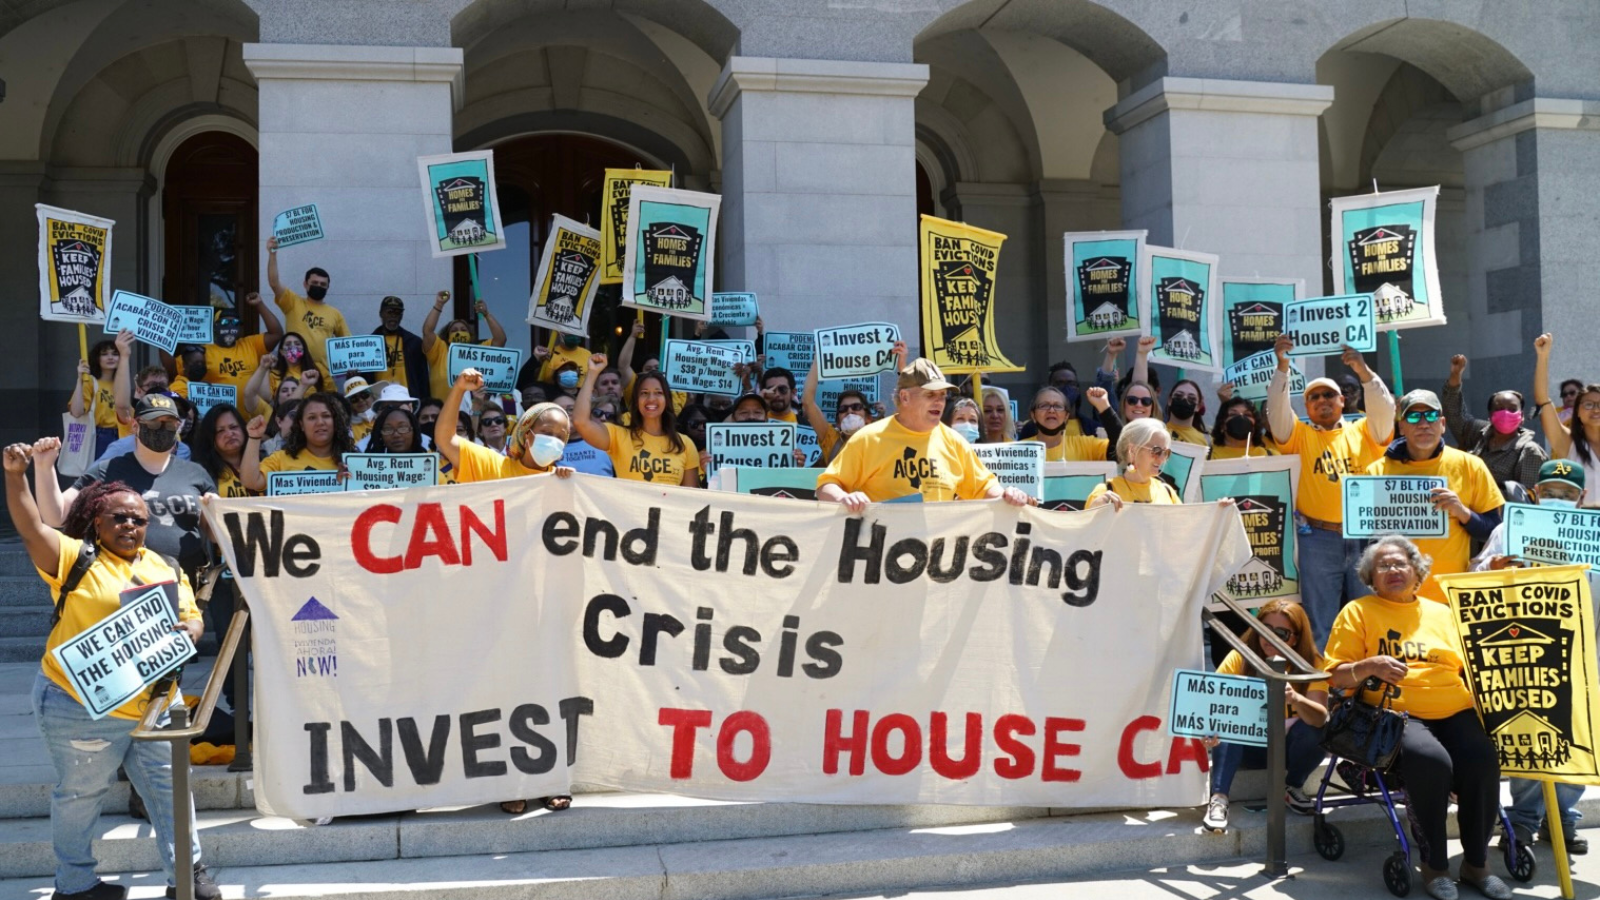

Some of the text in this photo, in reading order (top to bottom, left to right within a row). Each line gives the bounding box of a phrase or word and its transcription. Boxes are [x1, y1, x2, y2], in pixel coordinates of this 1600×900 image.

[448, 188, 474, 200] HOMES
[301, 207, 314, 216] FOR
[447, 200, 480, 212] FAMILIES
[289, 215, 316, 226] HOUSING
[53, 221, 104, 237] BAN COVID
[275, 224, 313, 237] PRODUCTION
[277, 229, 320, 244] PRESERVATION
[52, 231, 103, 246] EVICTIONS
[561, 231, 601, 250] BAN COVI
[657, 237, 687, 251] HOMES
[559, 240, 601, 260] EVICTIONS
[934, 237, 995, 260] BAN COVID
[1364, 240, 1399, 258] HOMES
[62, 253, 89, 265] KEEP
[653, 253, 692, 268] FAMILIES
[934, 250, 994, 272] EVICTIONS
[1361, 257, 1407, 276] FAMILIES
[61, 264, 94, 278] FAMILIES
[560, 261, 584, 274] KEEP
[1090, 269, 1118, 281] HOMES
[59, 275, 92, 288] HOUSED
[551, 282, 579, 296] HOUSED
[1088, 282, 1123, 294] FAMILIES
[1169, 291, 1192, 306] HOMES
[115, 302, 150, 318] ACABAR
[151, 313, 169, 326] CON
[169, 320, 178, 332] LA
[145, 300, 181, 323] PODEMOS
[718, 311, 746, 319] Creciente
[1300, 300, 1367, 323] Invest 2
[137, 317, 176, 339] CRISIS DE
[1243, 315, 1275, 327] HOMES
[136, 326, 173, 348] VIVIENDA
[196, 332, 206, 340] $14
[833, 327, 895, 346] Invest 2
[1240, 330, 1281, 342] FAMILIES
[1288, 324, 1368, 347] House CA
[334, 340, 377, 350] MÁS Fondos
[686, 344, 725, 357] Avg. Rent
[768, 342, 796, 351] ACABAR
[797, 343, 811, 351] CON
[348, 351, 365, 360] para
[458, 347, 511, 364] MÁS Fondos
[674, 352, 708, 366] Housing
[788, 352, 810, 360] CRISIS
[822, 349, 893, 370] House CA
[332, 359, 383, 370] MÁS Viviendas
[680, 364, 727, 377] $38 p/hour
[1234, 354, 1273, 374] WE CAN
[672, 374, 733, 389] Min. Wage: $14
[843, 383, 875, 393] HOUSING
[195, 386, 234, 397] WE CAN END
[725, 428, 790, 447] Invest 2
[566, 450, 596, 458] TENANTS
[566, 454, 596, 462] TOGETHER
[995, 447, 1038, 458] Viviendas
[366, 458, 414, 471] Avg. Rent
[629, 455, 672, 473] ACCE
[768, 453, 790, 468] CA
[894, 457, 940, 479] ACCE
[985, 459, 1029, 471] onómicas
[274, 477, 294, 488] Mas
[355, 470, 426, 485] Housing Wage:
[1384, 480, 1438, 491] $7 BL FOR
[1390, 493, 1439, 504] HOUSING
[1358, 506, 1439, 517] PRODUCTION &
[1359, 519, 1439, 530] PRESERVATION
[1553, 512, 1568, 525] $7
[1571, 514, 1586, 527] BL
[1254, 546, 1280, 556] PROFIT!
[1522, 535, 1600, 553] PRODUCTION
[223, 499, 1103, 608] We CAN end the Housing
[1523, 547, 1600, 566] PRESERVATIO
[1458, 586, 1571, 608] BAN COVID
[1459, 601, 1574, 624] EVICTIONS
[75, 596, 163, 660] WE CAN END
[294, 620, 335, 634] HOUSING
[583, 593, 845, 680] Crisis
[77, 617, 172, 687] THE HOUSING
[136, 636, 186, 678] CRISIS
[296, 645, 336, 656] AHORA!
[1481, 645, 1545, 667] KEEP
[1479, 667, 1561, 692] FAMILIES
[1187, 675, 1265, 700] MÁS Fondos
[1209, 702, 1239, 716] para
[1479, 689, 1557, 714] HOUSED
[1176, 712, 1268, 738] MÁS Viviendas
[303, 696, 1210, 795] INVEST TO HOUSE CA
